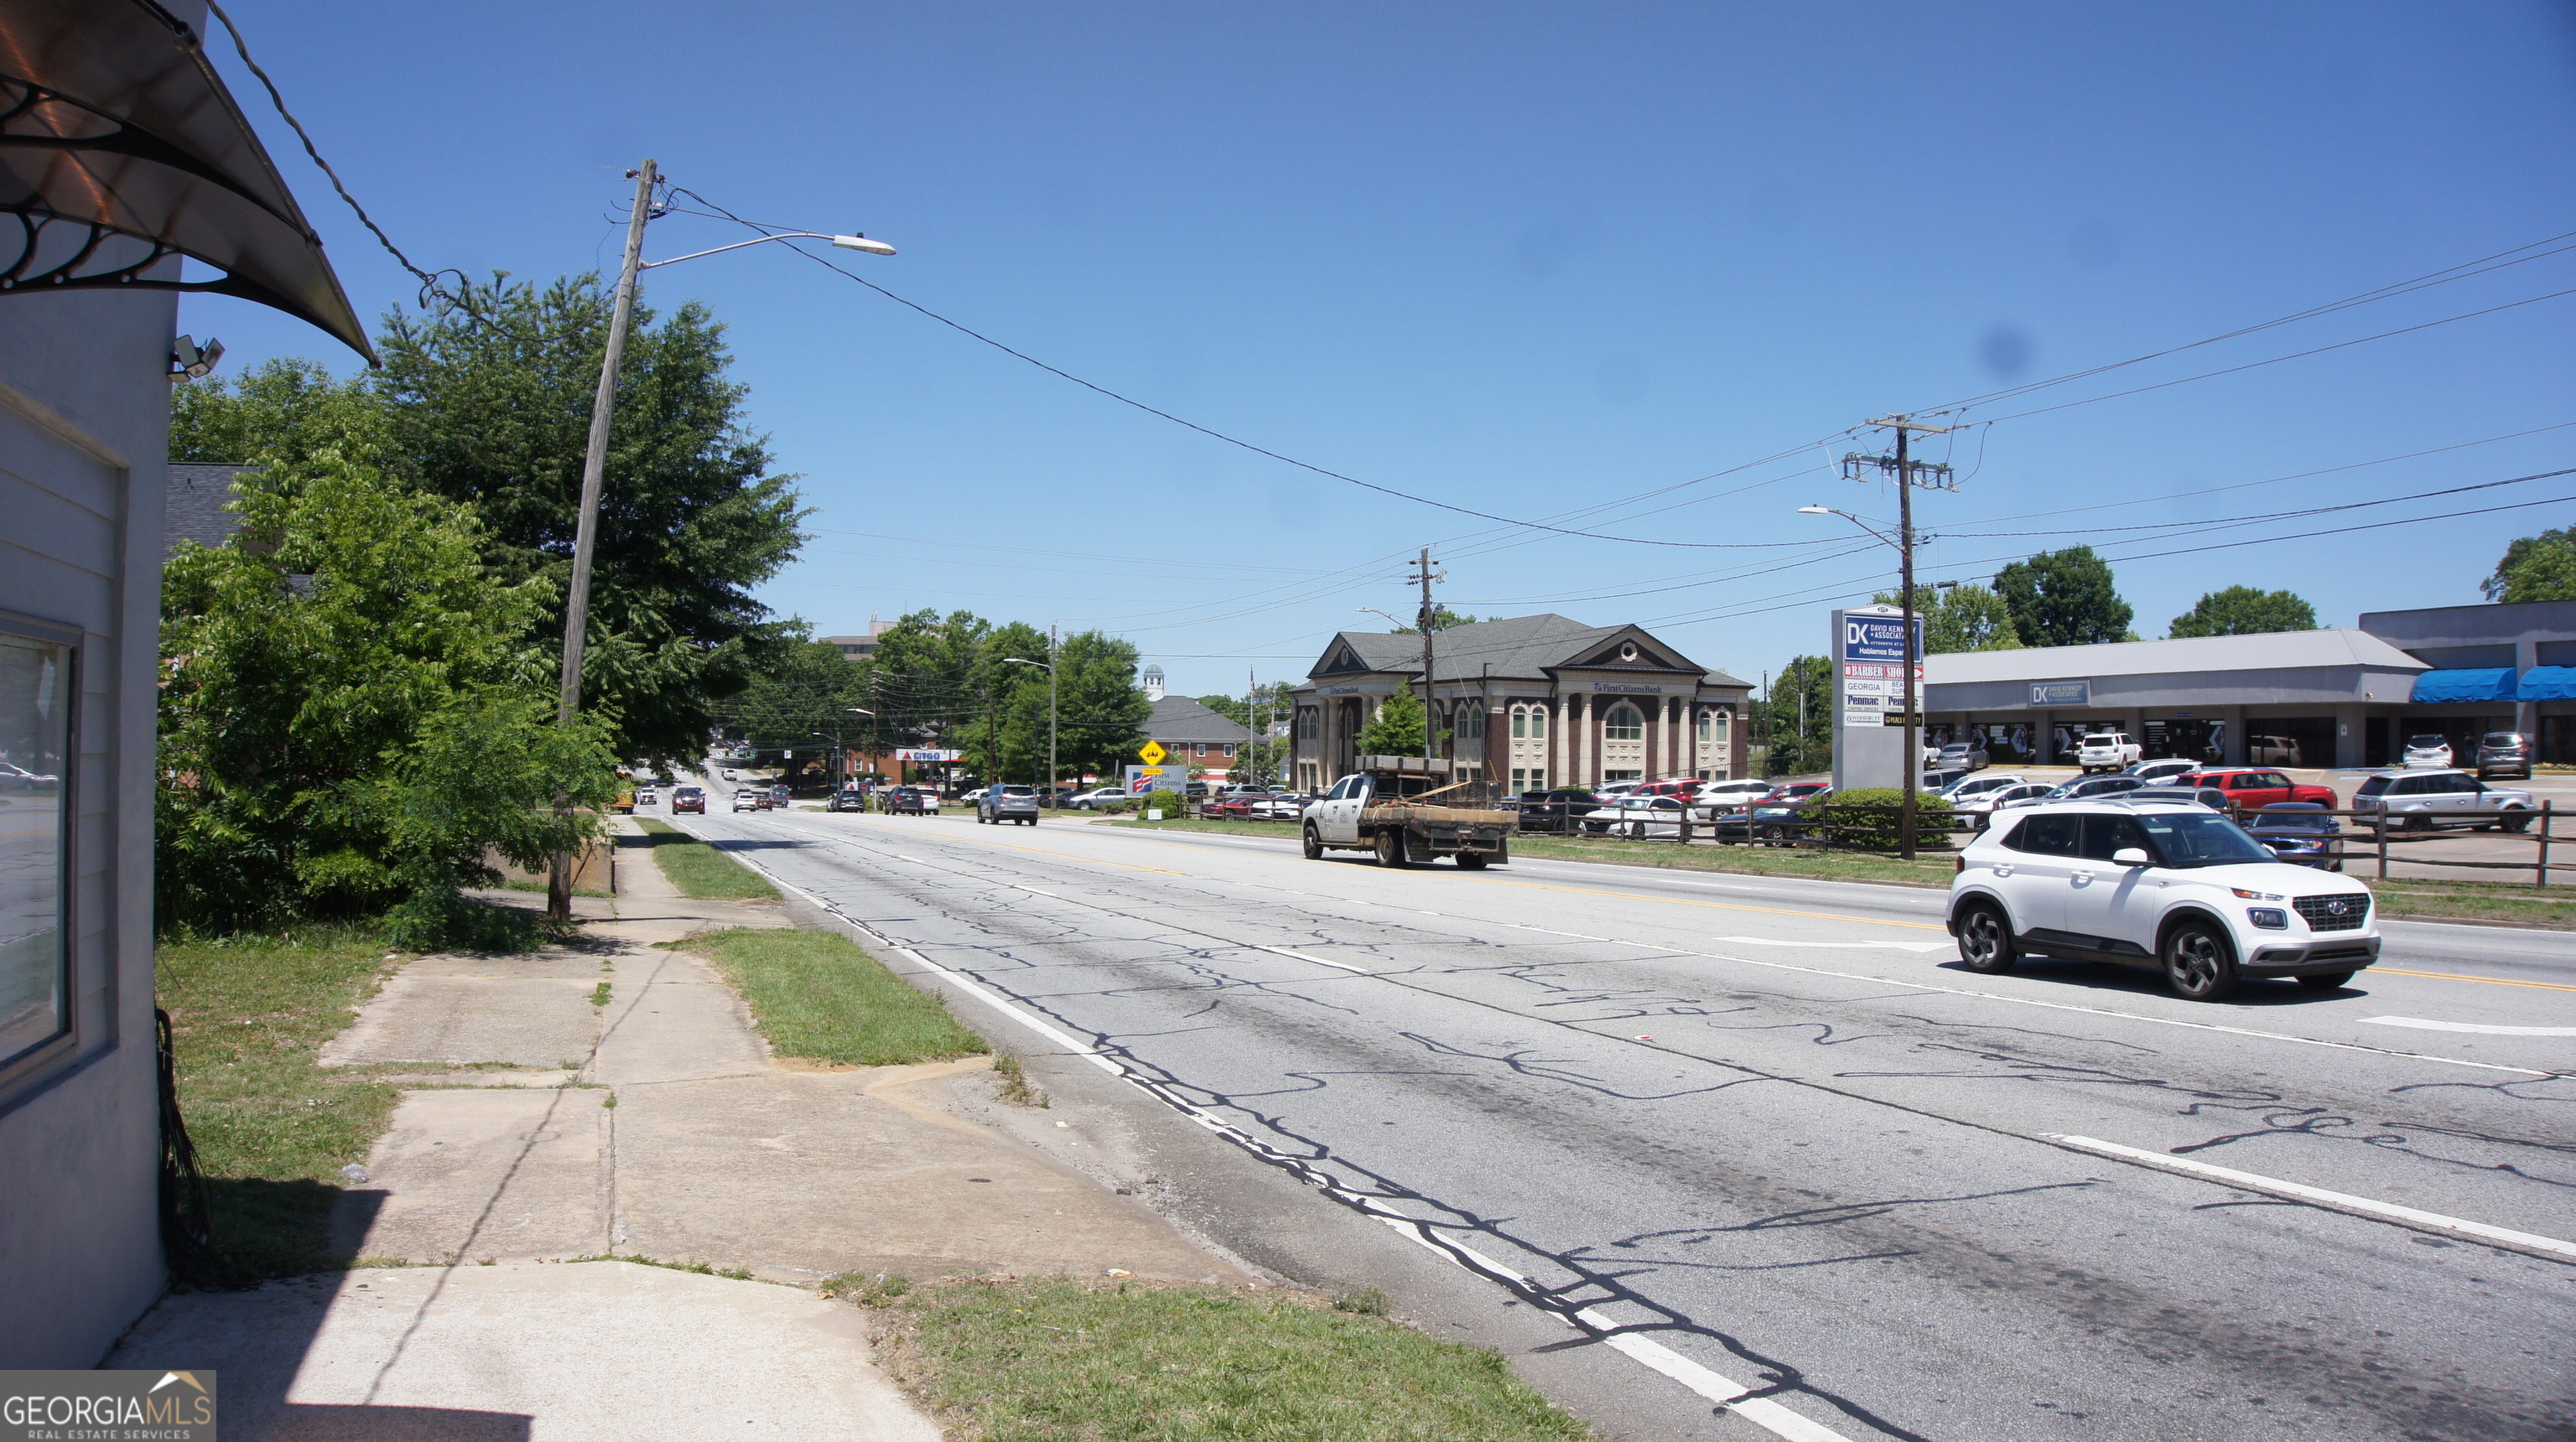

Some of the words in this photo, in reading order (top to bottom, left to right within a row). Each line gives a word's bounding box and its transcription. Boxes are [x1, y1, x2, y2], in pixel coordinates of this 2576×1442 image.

[1847, 623, 1869, 645] DK
[1859, 647, 1887, 656] Hablamos
[1852, 666, 1883, 677] BARBER
[1886, 667, 1904, 677] SHO
[1847, 682, 1881, 691] GEORGIA
[1847, 695, 1879, 706] Penmac
[2033, 687, 2048, 703] DK
